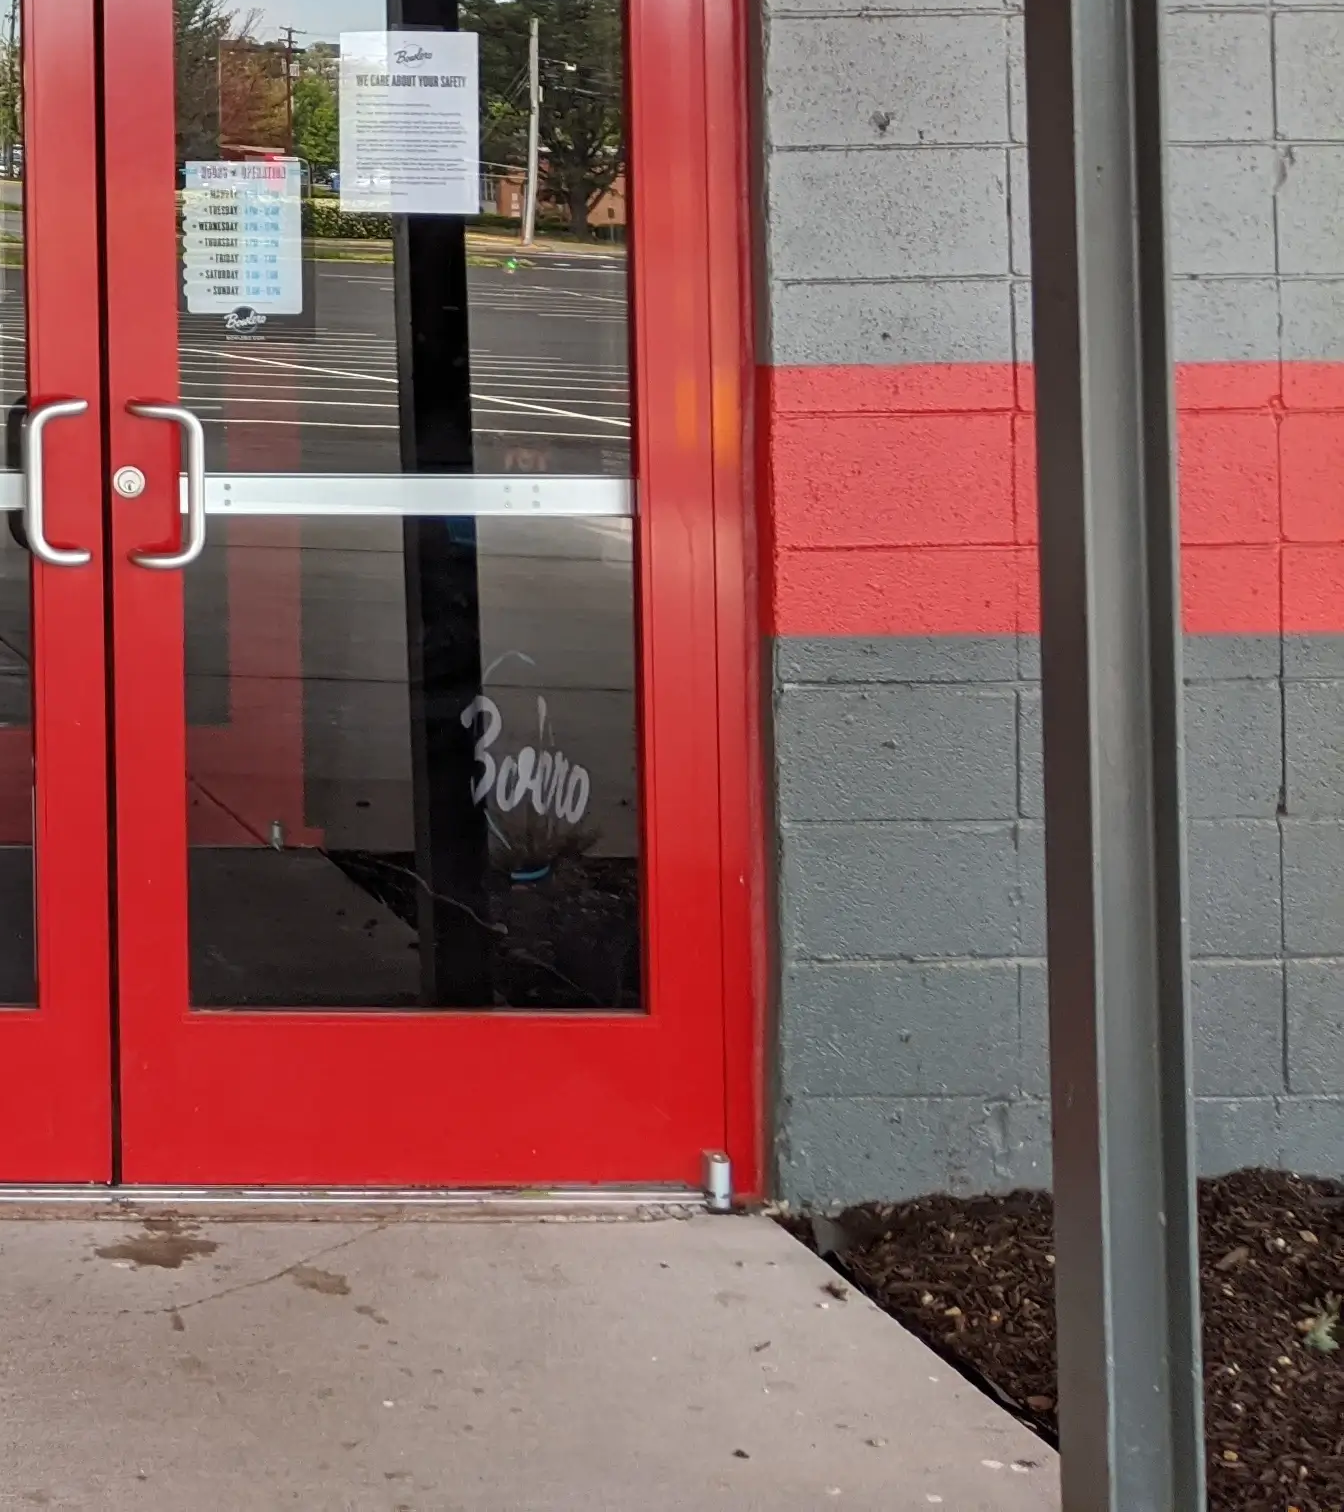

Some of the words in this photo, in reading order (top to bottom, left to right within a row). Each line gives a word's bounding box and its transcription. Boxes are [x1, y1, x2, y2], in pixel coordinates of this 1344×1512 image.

[393, 48, 433, 64] Bowlero
[356, 75, 369, 87] WE
[370, 75, 390, 87] CARE
[391, 75, 416, 88] ABOUT
[418, 75, 439, 88] YOUR
[440, 76, 467, 88] SAFETY
[208, 206, 238, 215] TUESDAY
[198, 221, 239, 231] WEDNESDAY
[204, 238, 239, 247] THURSDAY
[215, 254, 239, 263] FRIDAY
[205, 269, 239, 279] SATURDAY
[213, 285, 239, 295] SUNDAY
[223, 310, 267, 329] Bowlero
